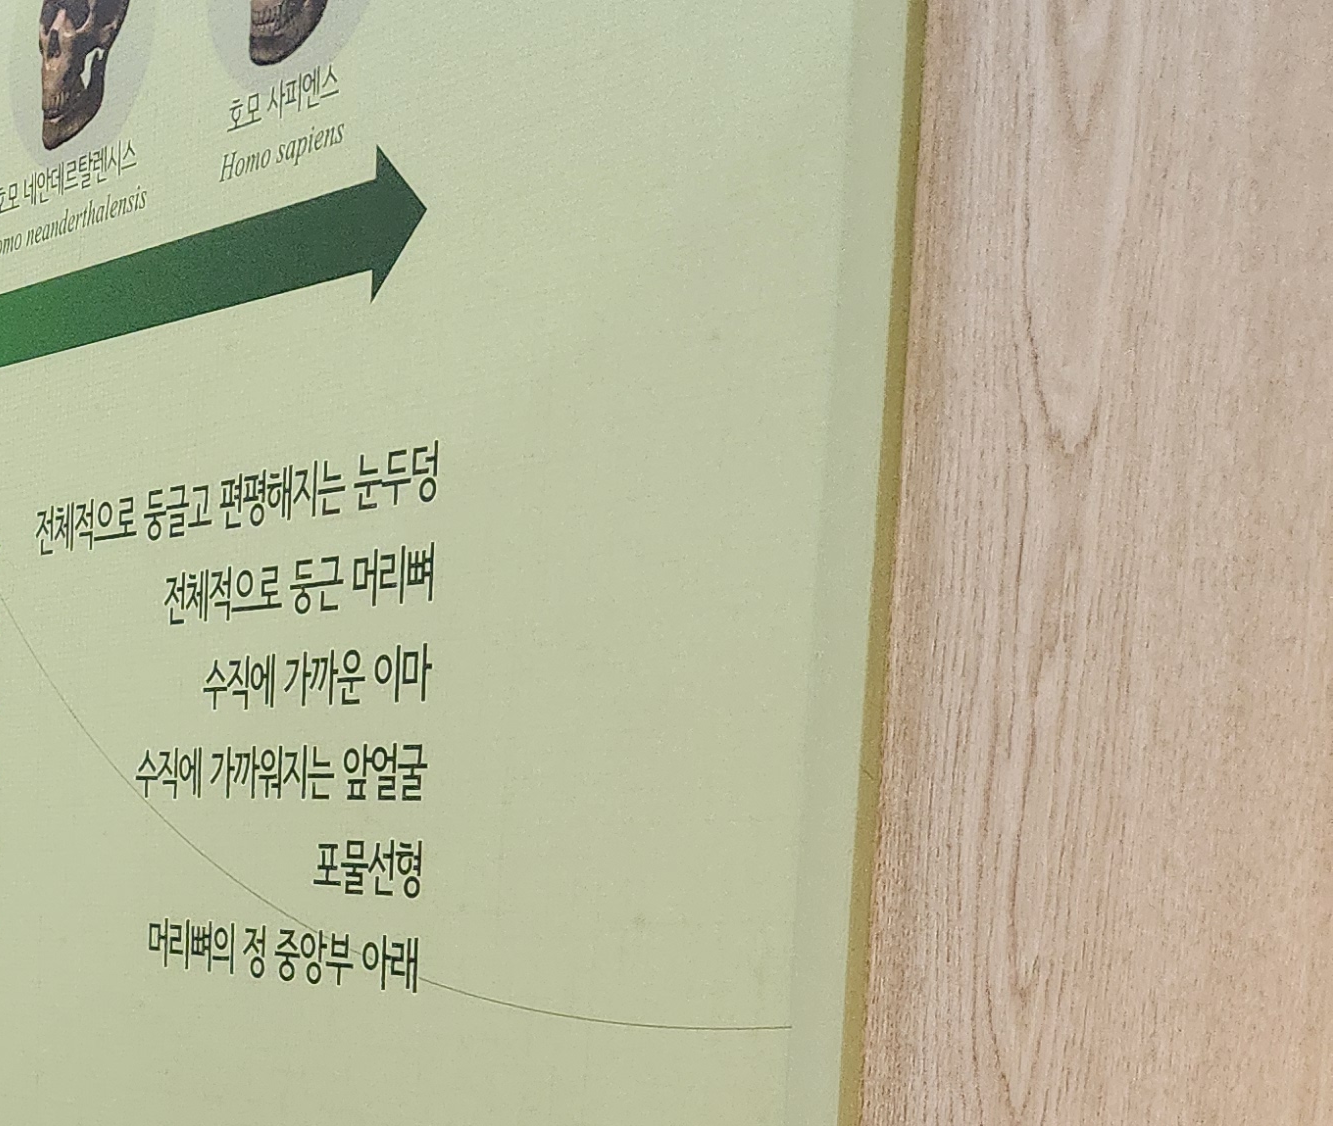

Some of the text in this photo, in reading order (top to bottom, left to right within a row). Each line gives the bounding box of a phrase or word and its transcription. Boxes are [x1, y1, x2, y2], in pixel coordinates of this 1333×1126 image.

[226, 64, 340, 134] 호모 사피엔스
[23, 140, 138, 207] 네안데르탈렌시스
[219, 119, 346, 184] Homo sapiens
[25, 183, 149, 246] neanderthalensis
[34, 439, 440, 557] 전체적으로 둥글고 편평해지는 눈두덩
[164, 541, 436, 626] 전체적으로 둥근 머리뼈
[202, 642, 433, 711] 수직에 가까운 이마
[135, 742, 429, 803] 수직에 가까워지는 앞얼굴
[312, 838, 424, 899] 포물선형
[147, 917, 419, 994] 머리뼈의 정 중앙부 아래
